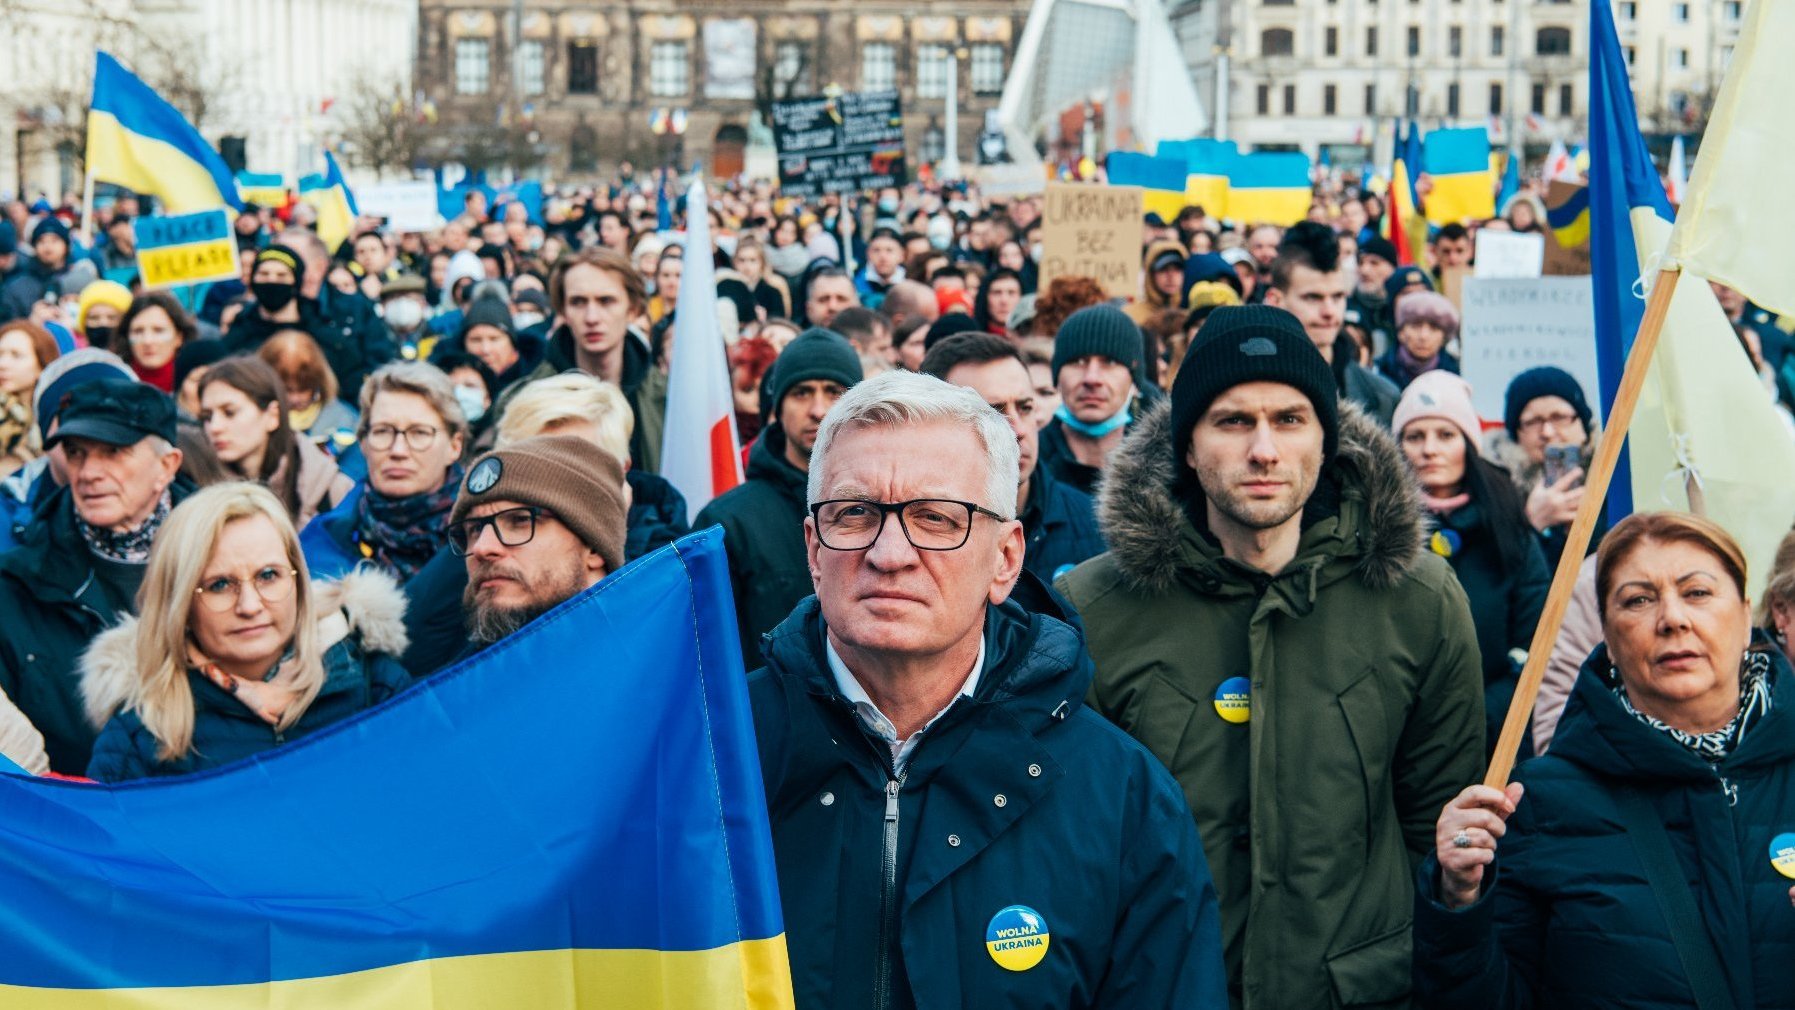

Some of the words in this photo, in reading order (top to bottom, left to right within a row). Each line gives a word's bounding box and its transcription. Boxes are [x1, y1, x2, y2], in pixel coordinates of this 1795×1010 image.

[1047, 191, 1139, 224] UKRAINA
[153, 217, 214, 242] PEACE
[1077, 230, 1114, 254] BEZ
[996, 925, 1037, 938] WOLNA
[994, 938, 1043, 951] UKRAINA
